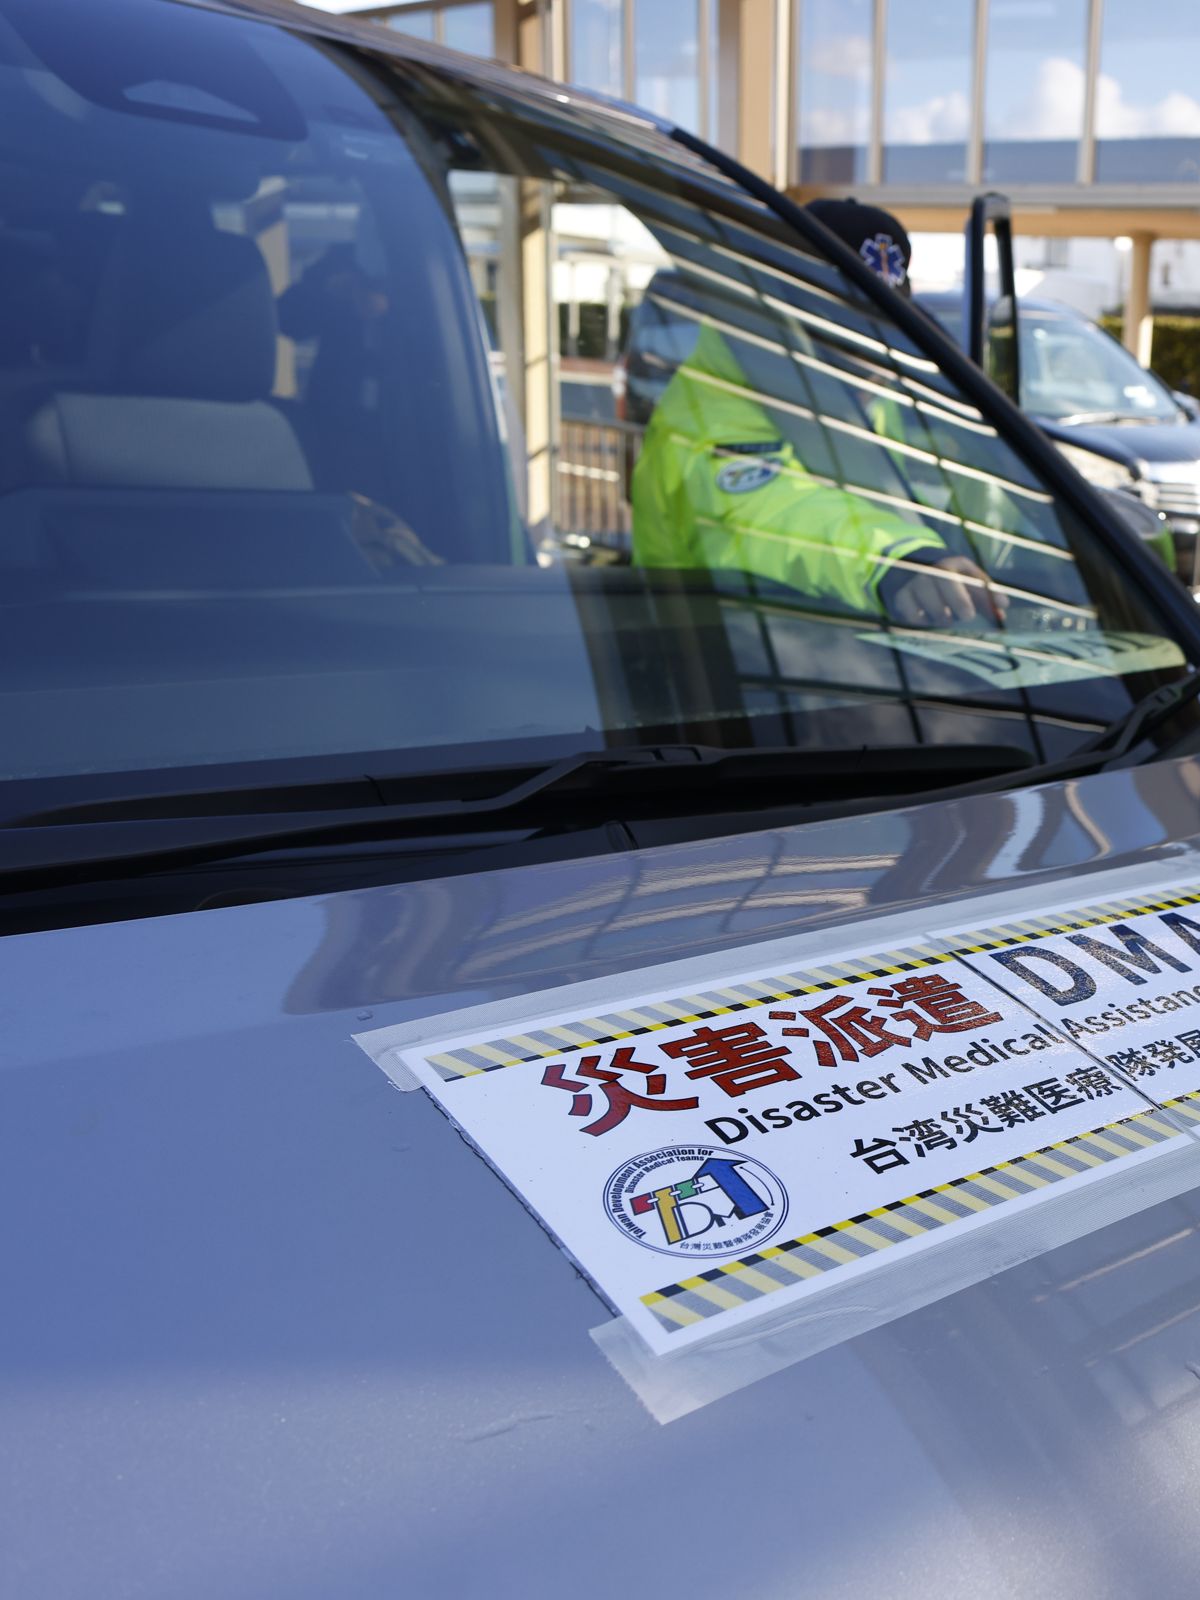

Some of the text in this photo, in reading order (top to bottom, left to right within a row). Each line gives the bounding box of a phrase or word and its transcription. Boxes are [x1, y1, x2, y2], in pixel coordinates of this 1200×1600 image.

[541, 974, 1004, 1137] 災害派遣
[704, 1071, 901, 1144] Disaster
[901, 1023, 1065, 1084] Medical
[610, 1148, 714, 1239] Taiwan Development Association for
[624, 1155, 705, 1193] Disaster Medical Teams
